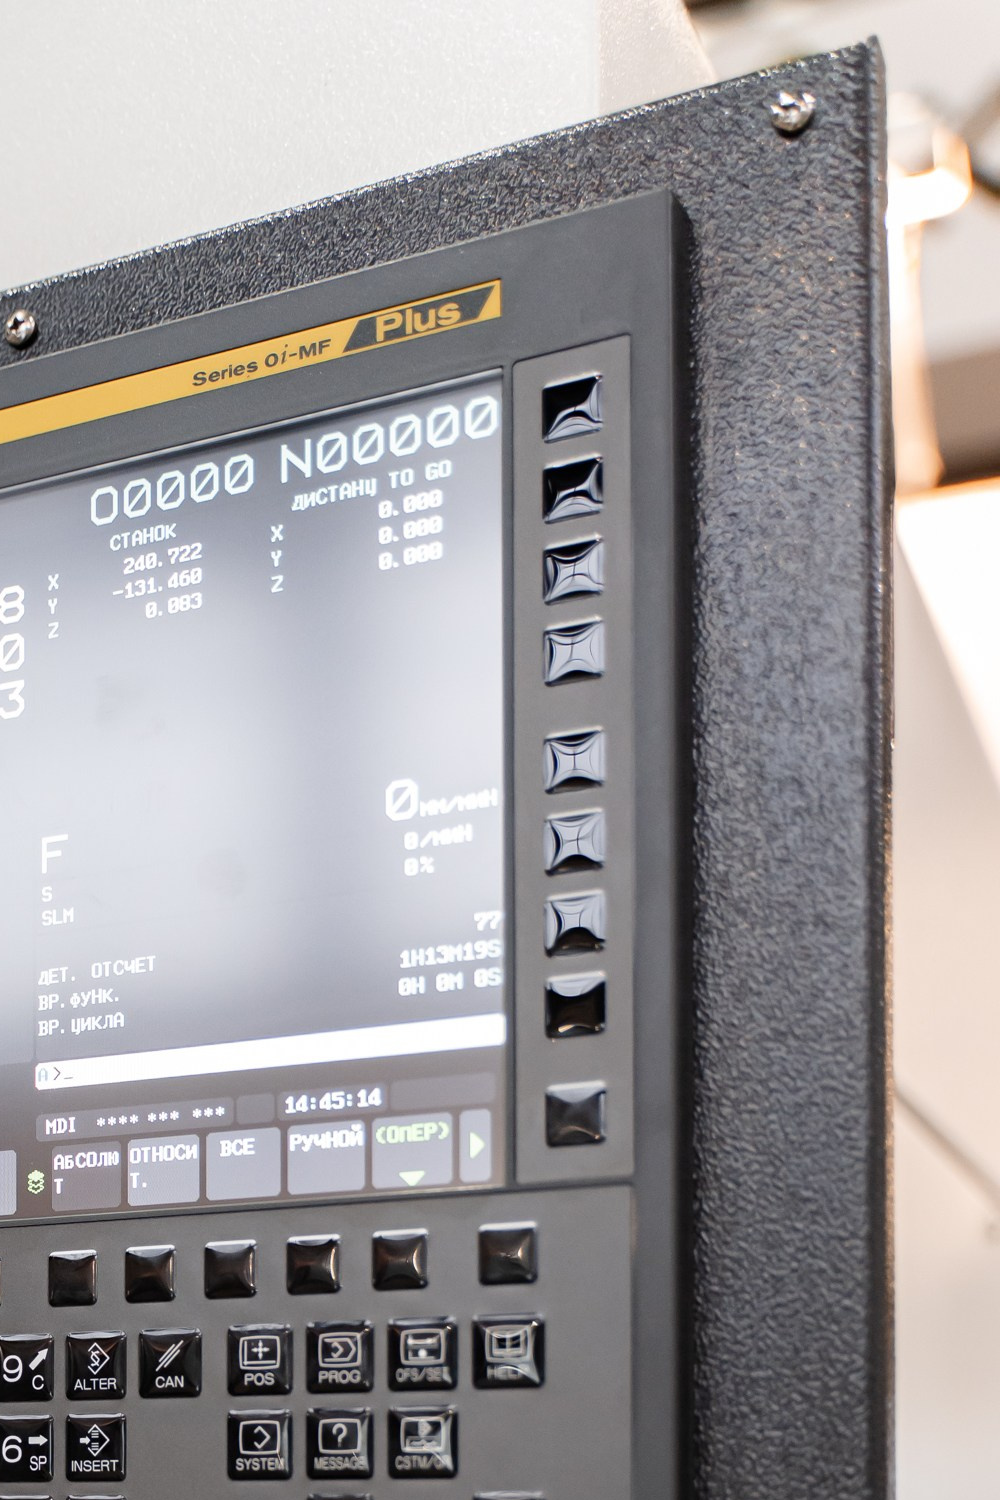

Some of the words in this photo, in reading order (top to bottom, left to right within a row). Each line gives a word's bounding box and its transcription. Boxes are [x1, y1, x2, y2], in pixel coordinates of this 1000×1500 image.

[192, 358, 258, 387] Series
[376, 300, 461, 343] Plus
[280, 395, 498, 485] N00000
[425, 459, 452, 482] GO
[378, 489, 443, 520] 0.000
[109, 523, 177, 552] СТАНОК
[378, 516, 443, 546] 0.000
[123, 543, 202, 576] 240.722
[378, 542, 443, 572] 0.000
[112, 568, 202, 601] -131.460
[144, 593, 202, 620] 0.083
[41, 834, 69, 874] F
[41, 907, 75, 927] SLM
[474, 910, 503, 931] 77
[37, 966, 77, 987] ДЕТ.
[90, 955, 157, 980] ОТСЧЕТ
[284, 1087, 382, 1114] 14:45:14
[45, 1117, 76, 1135] MDI
[289, 1124, 365, 1153] РУЧНОЙ
[130, 1144, 198, 1164] ОТНОСИ
[74, 1378, 117, 1391] ALTER
[155, 1376, 184, 1389] CAN
[244, 1373, 275, 1386] POS
[318, 1370, 361, 1384] PROG
[29, 1456, 47, 1471] SP
[71, 1460, 118, 1472] INSERT
[236, 1457, 284, 1471] SYSTEM
[314, 1456, 366, 1470] MESSAGE
